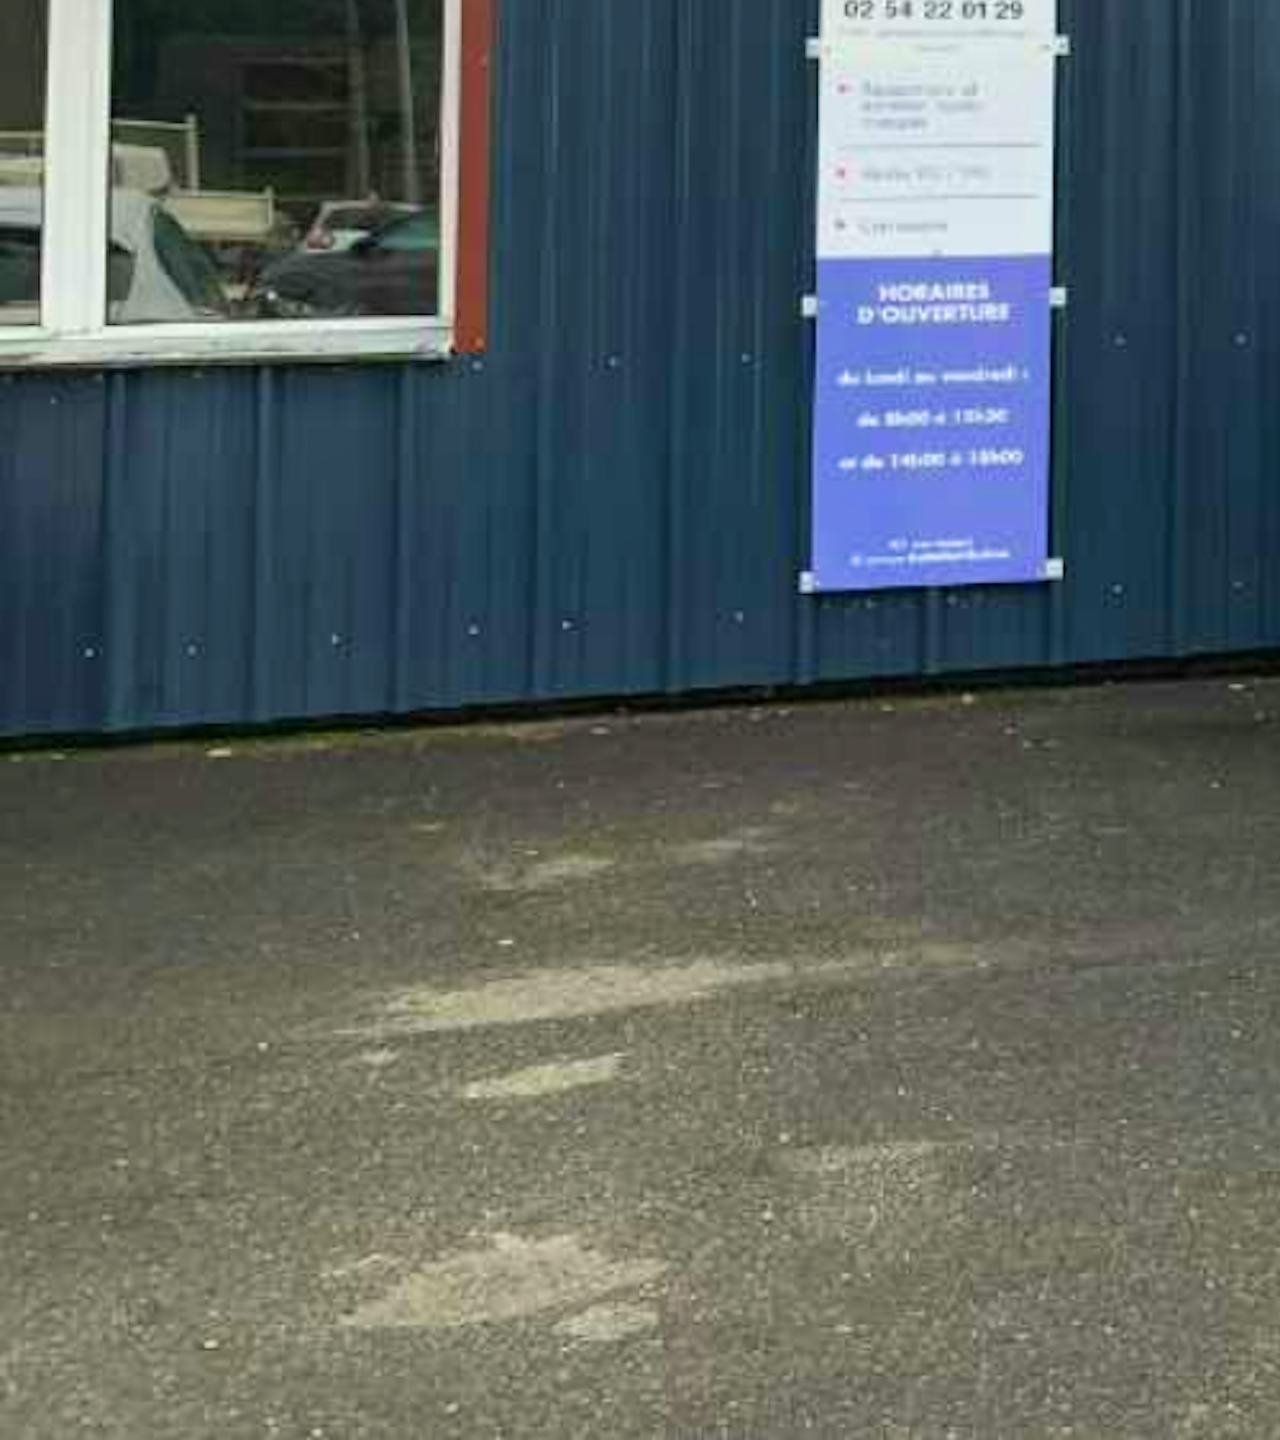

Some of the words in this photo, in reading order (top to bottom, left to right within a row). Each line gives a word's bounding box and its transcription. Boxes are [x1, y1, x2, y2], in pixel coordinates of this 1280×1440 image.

[923, 0, 953, 20] 22
[962, 0, 987, 20] 01
[994, 0, 1024, 20] 29
[879, 282, 990, 302] HORAIRES
